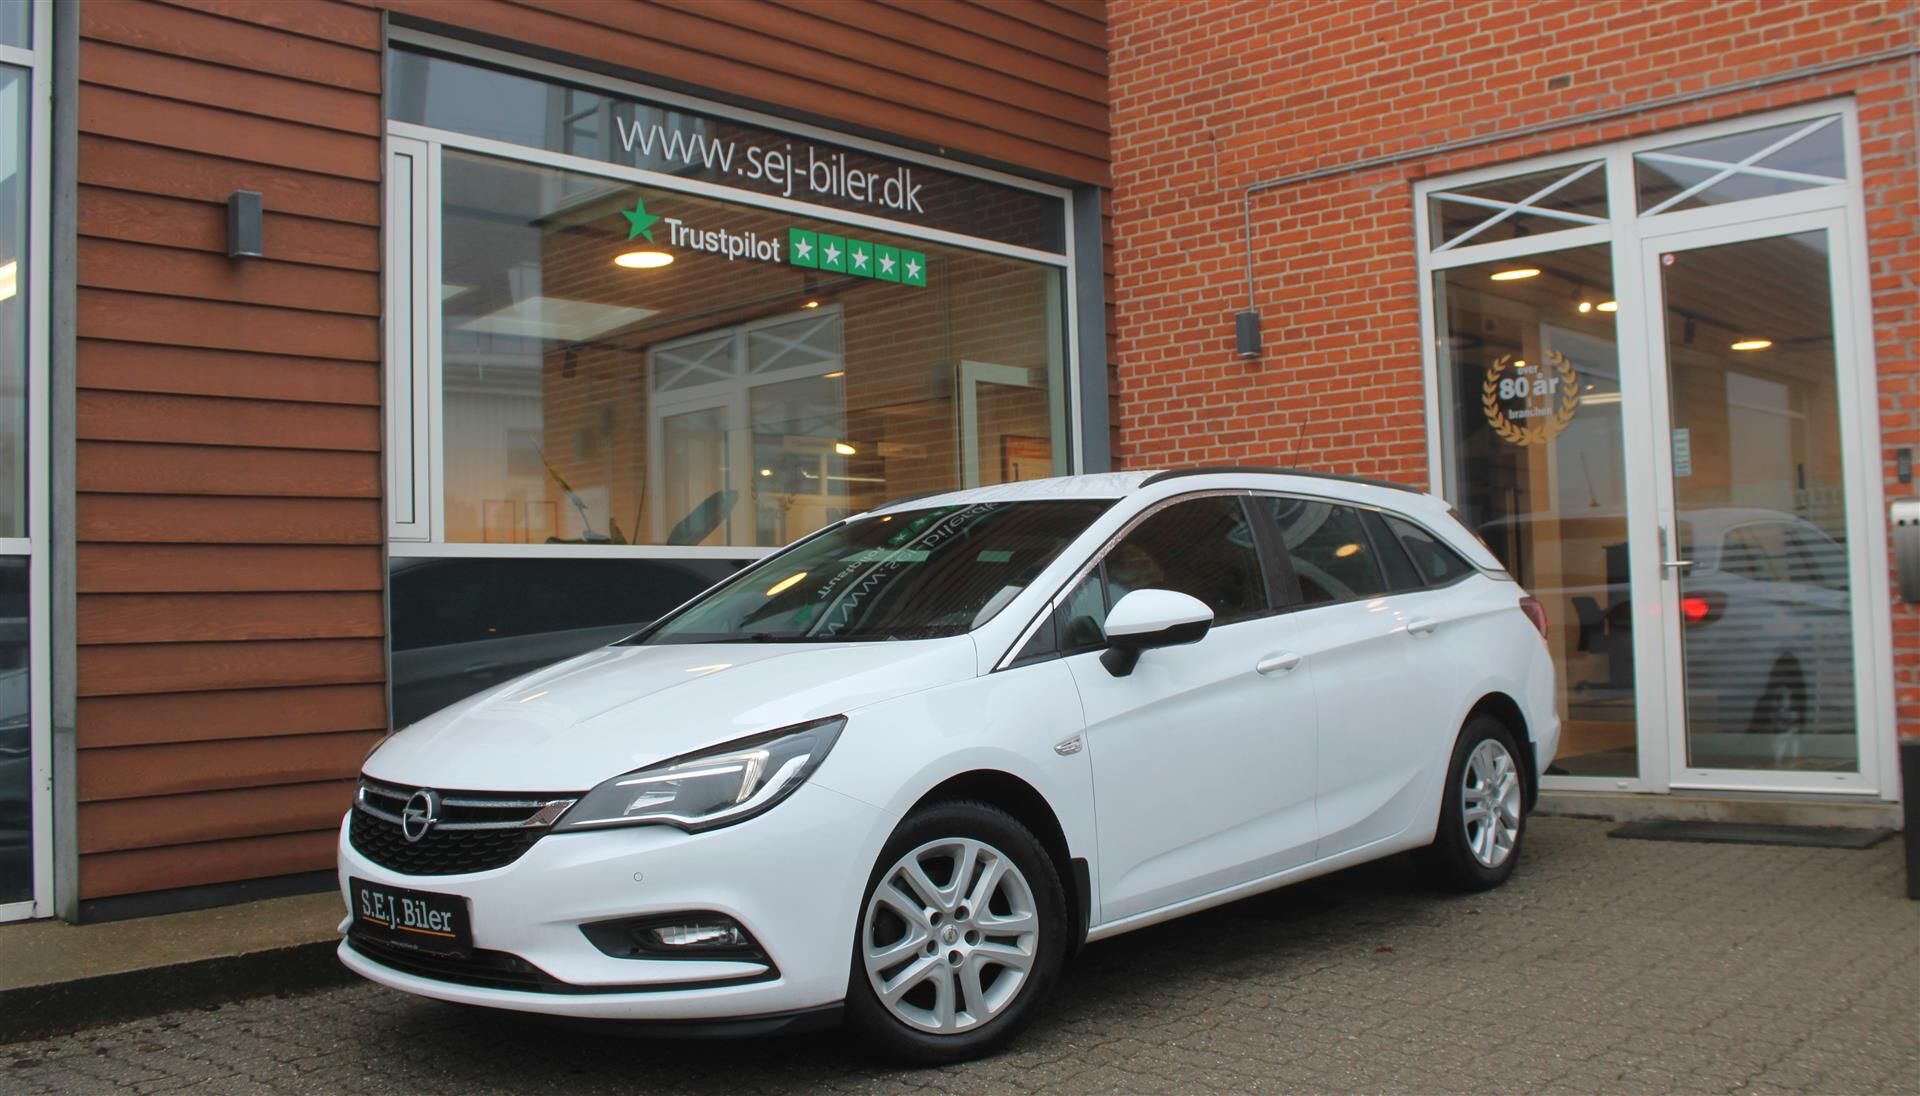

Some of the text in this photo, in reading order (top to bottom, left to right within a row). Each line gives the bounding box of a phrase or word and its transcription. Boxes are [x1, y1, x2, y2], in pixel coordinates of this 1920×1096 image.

[616, 115, 925, 214] www.sej-biler.dk
[664, 217, 782, 263] Trustpilot
[1499, 372, 1559, 400] 80 år
[361, 889, 452, 932] S.E.J. Biler
